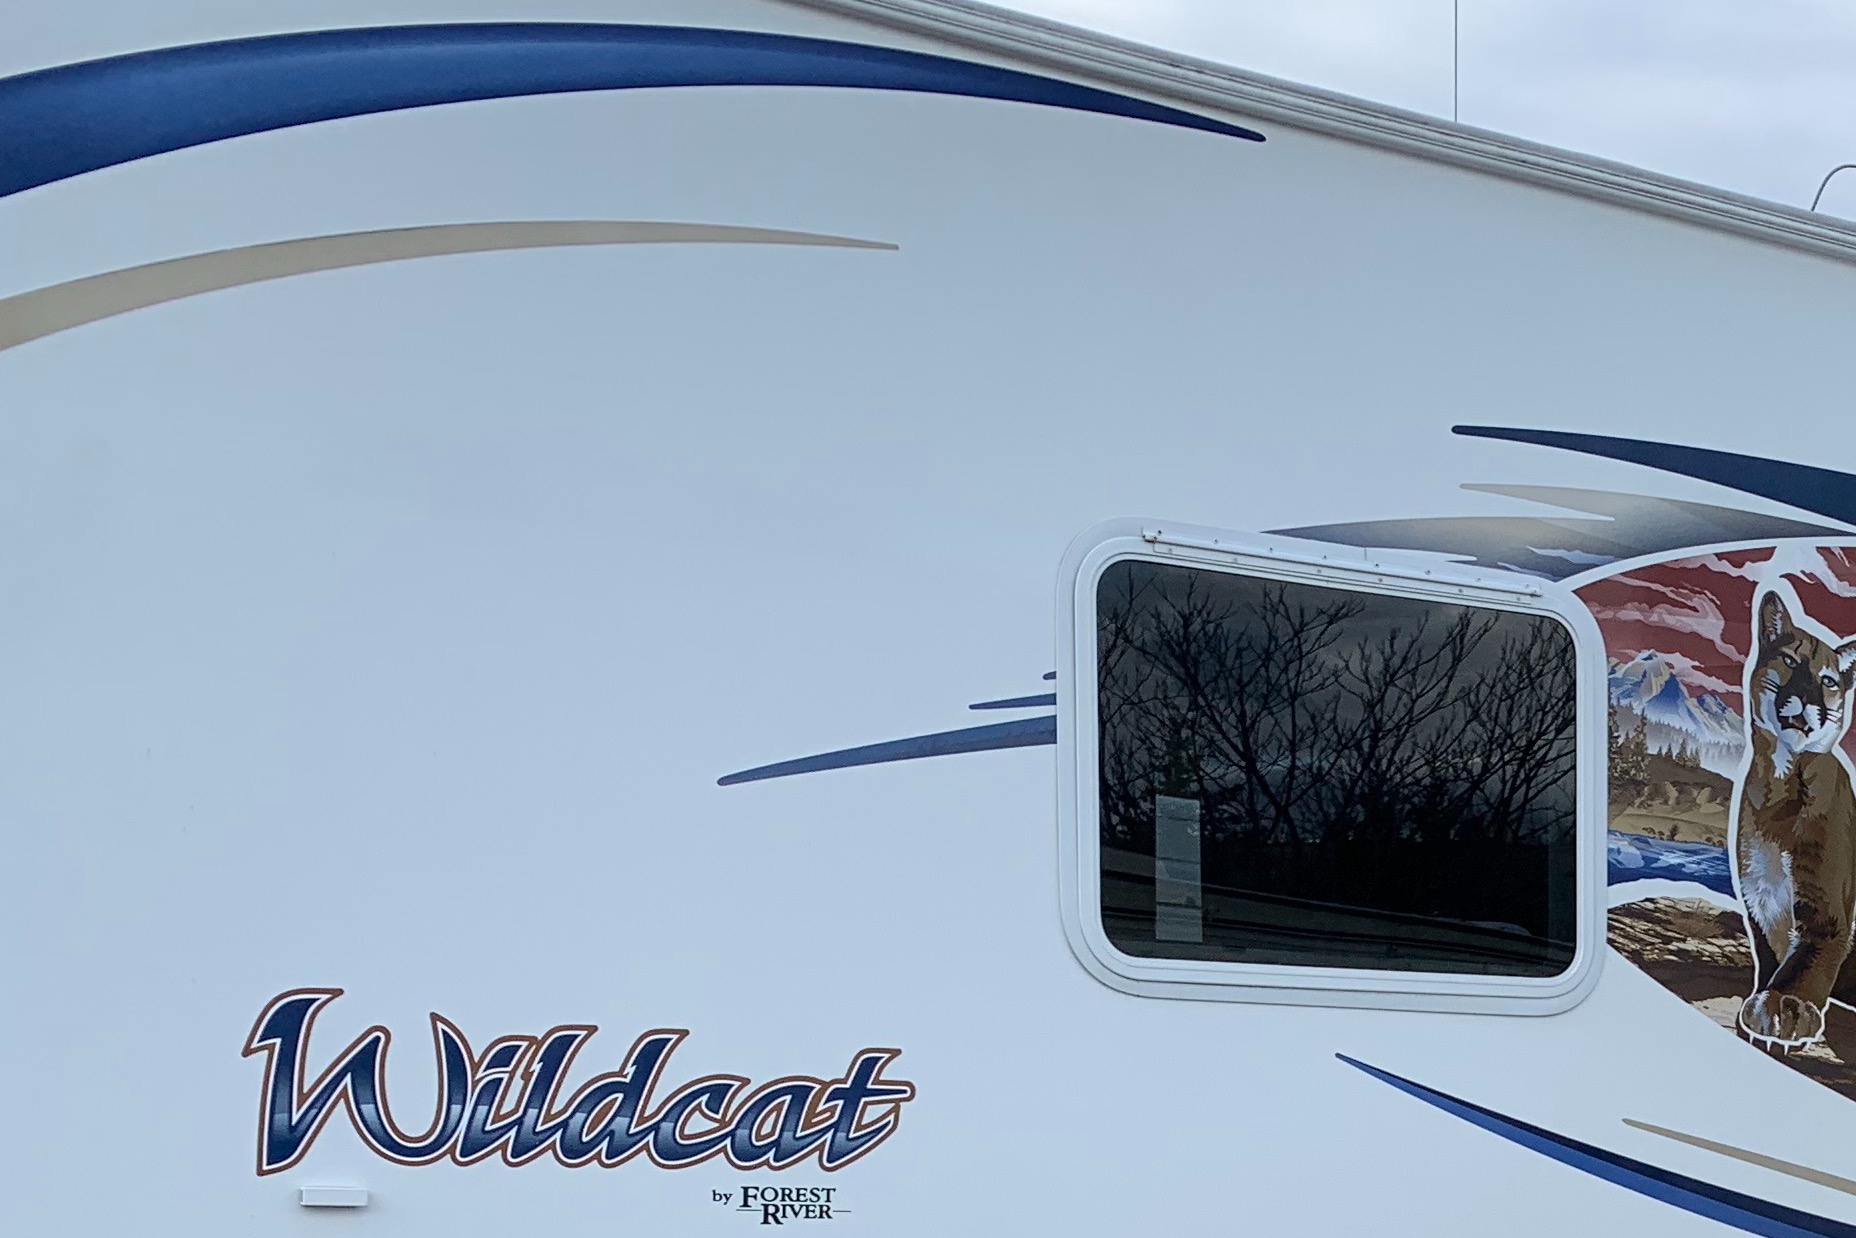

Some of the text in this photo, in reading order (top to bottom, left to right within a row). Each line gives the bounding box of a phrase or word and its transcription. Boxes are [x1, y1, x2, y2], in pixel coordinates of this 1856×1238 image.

[241, 987, 916, 1176] Wildcat
[711, 1186, 837, 1208] by FOREST
[760, 1203, 833, 1225] RIVER
